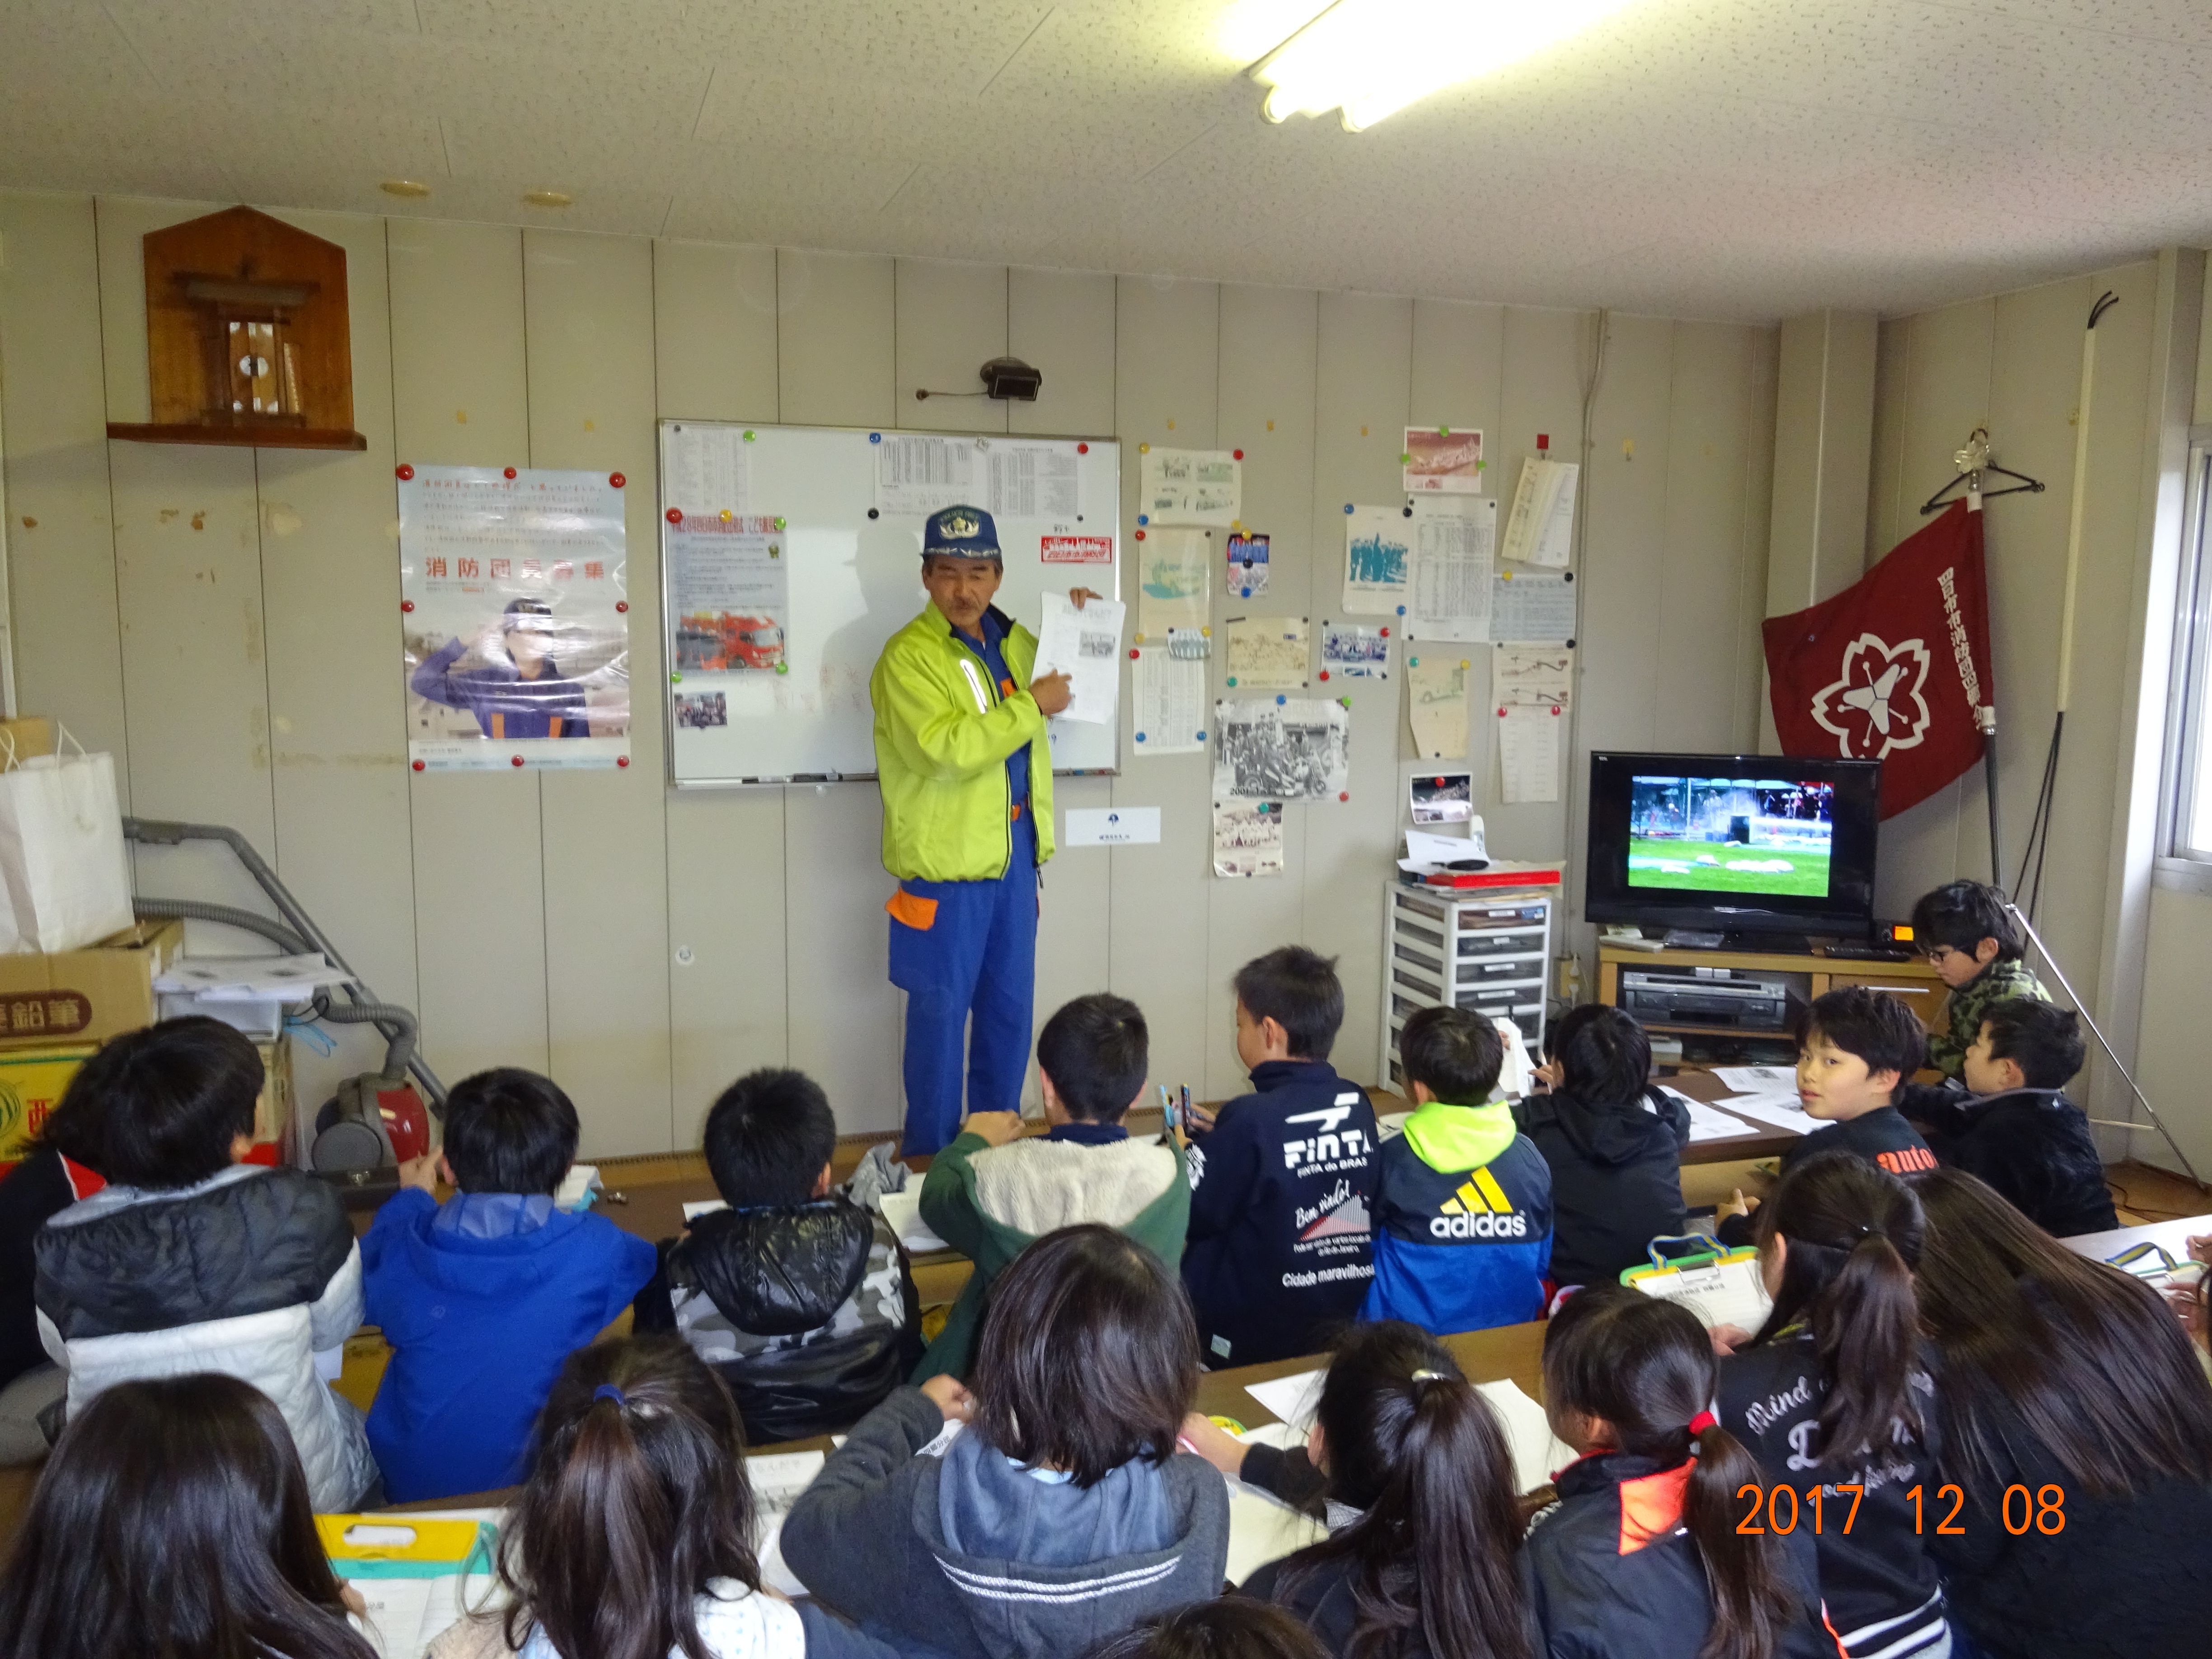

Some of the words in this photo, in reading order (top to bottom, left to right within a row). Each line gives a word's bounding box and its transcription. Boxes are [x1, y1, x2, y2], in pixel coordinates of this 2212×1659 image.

[0, 999, 80, 1031] 鉛筆
[1429, 1210, 1527, 1238] adidas
[1282, 1270, 1317, 1288] Cidade
[1745, 1375, 1813, 1435] Mind
